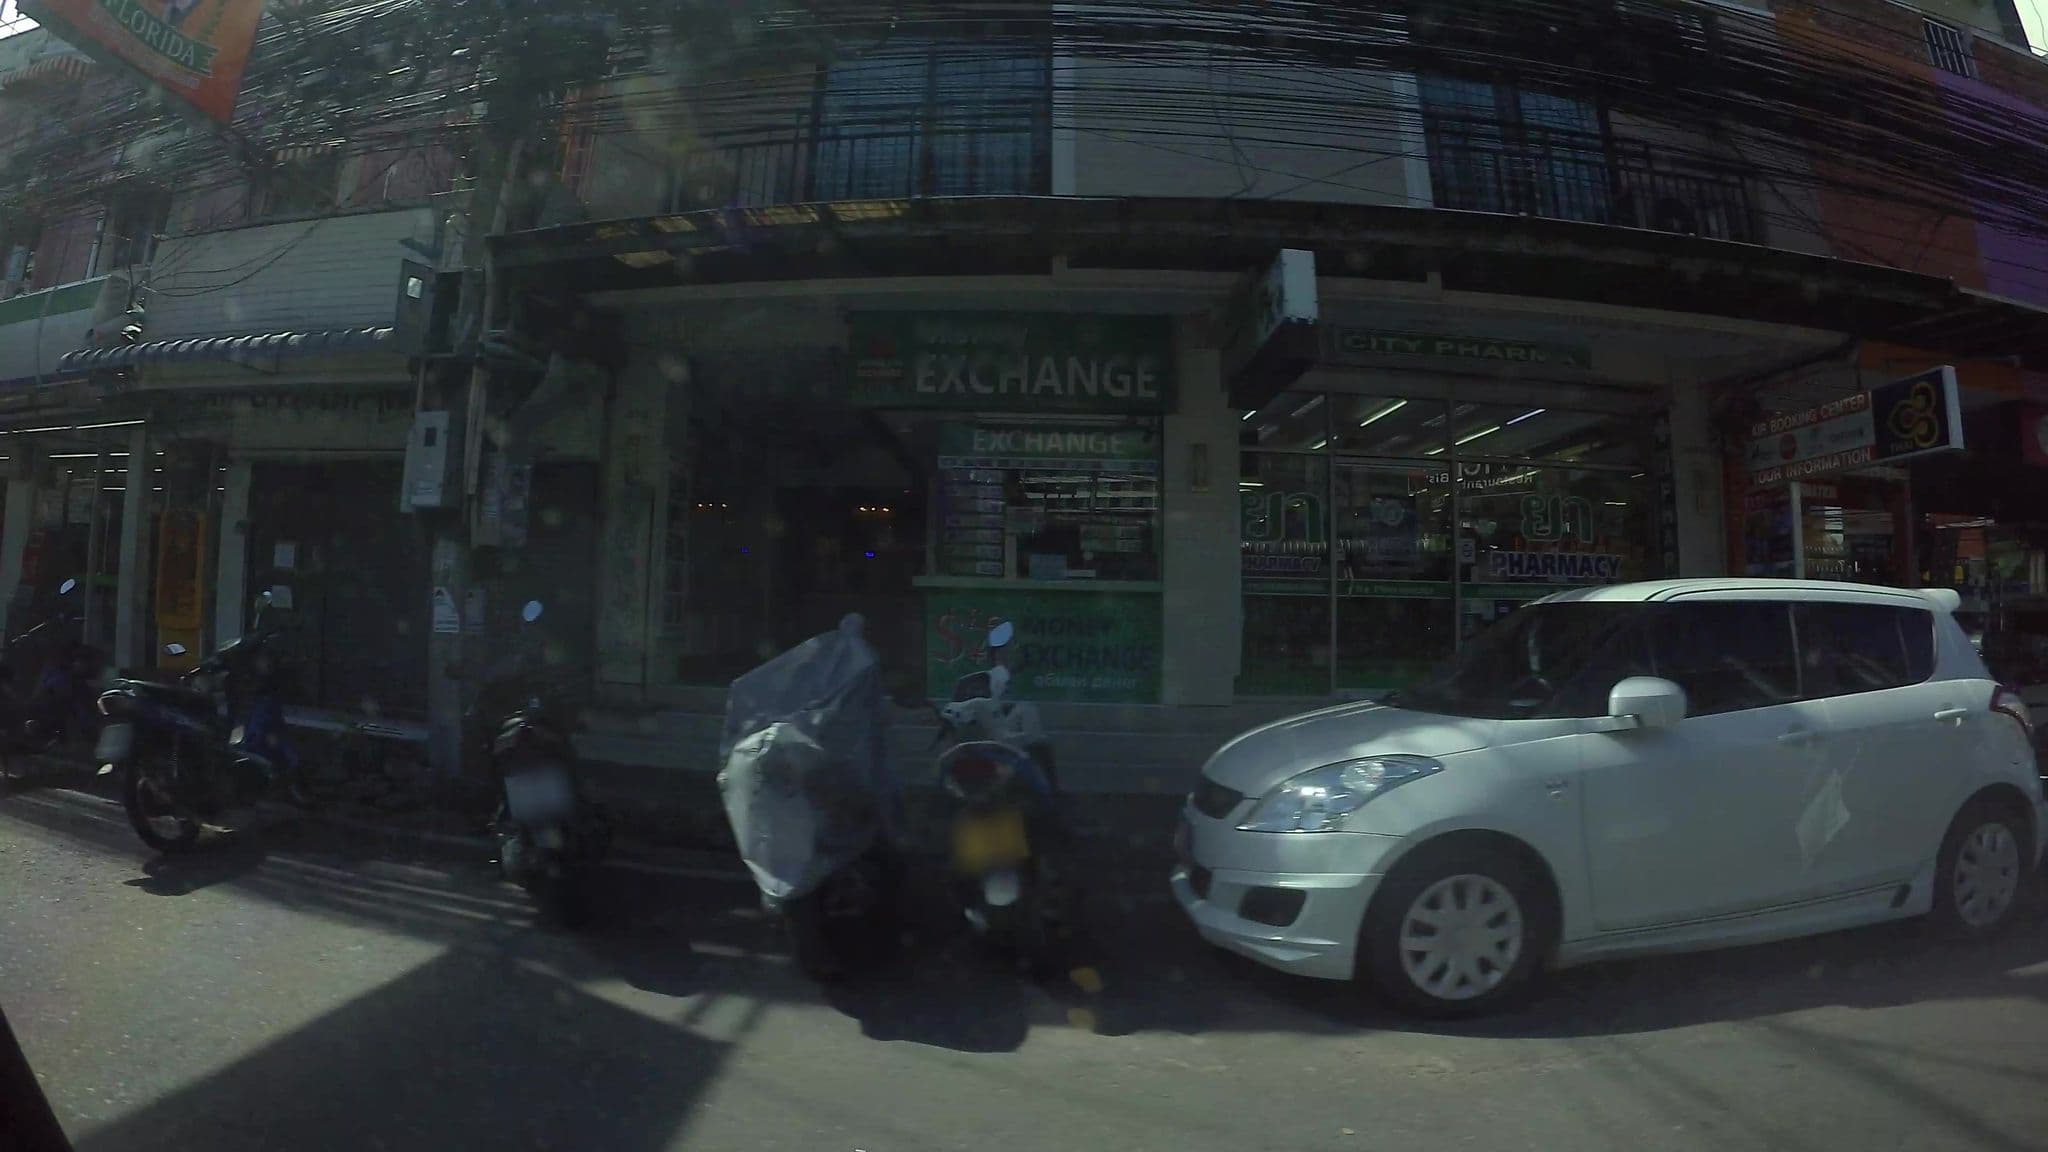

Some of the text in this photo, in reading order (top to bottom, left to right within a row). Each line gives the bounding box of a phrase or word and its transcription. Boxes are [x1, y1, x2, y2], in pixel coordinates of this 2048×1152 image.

[104, 0, 195, 66] LORIDA
[1344, 335, 1424, 353] CITY
[914, 354, 1159, 397] EXCHANGE
[1769, 408, 1818, 433] BOOKING
[1819, 394, 1866, 419] CENTER
[973, 430, 1128, 454] EXCHANGE
[1786, 449, 1872, 478] INFORMATION
[1489, 551, 1625, 582] PHARMACY
[1020, 616, 1115, 635] MONEY
[1020, 646, 1154, 672] EXCHANGE
